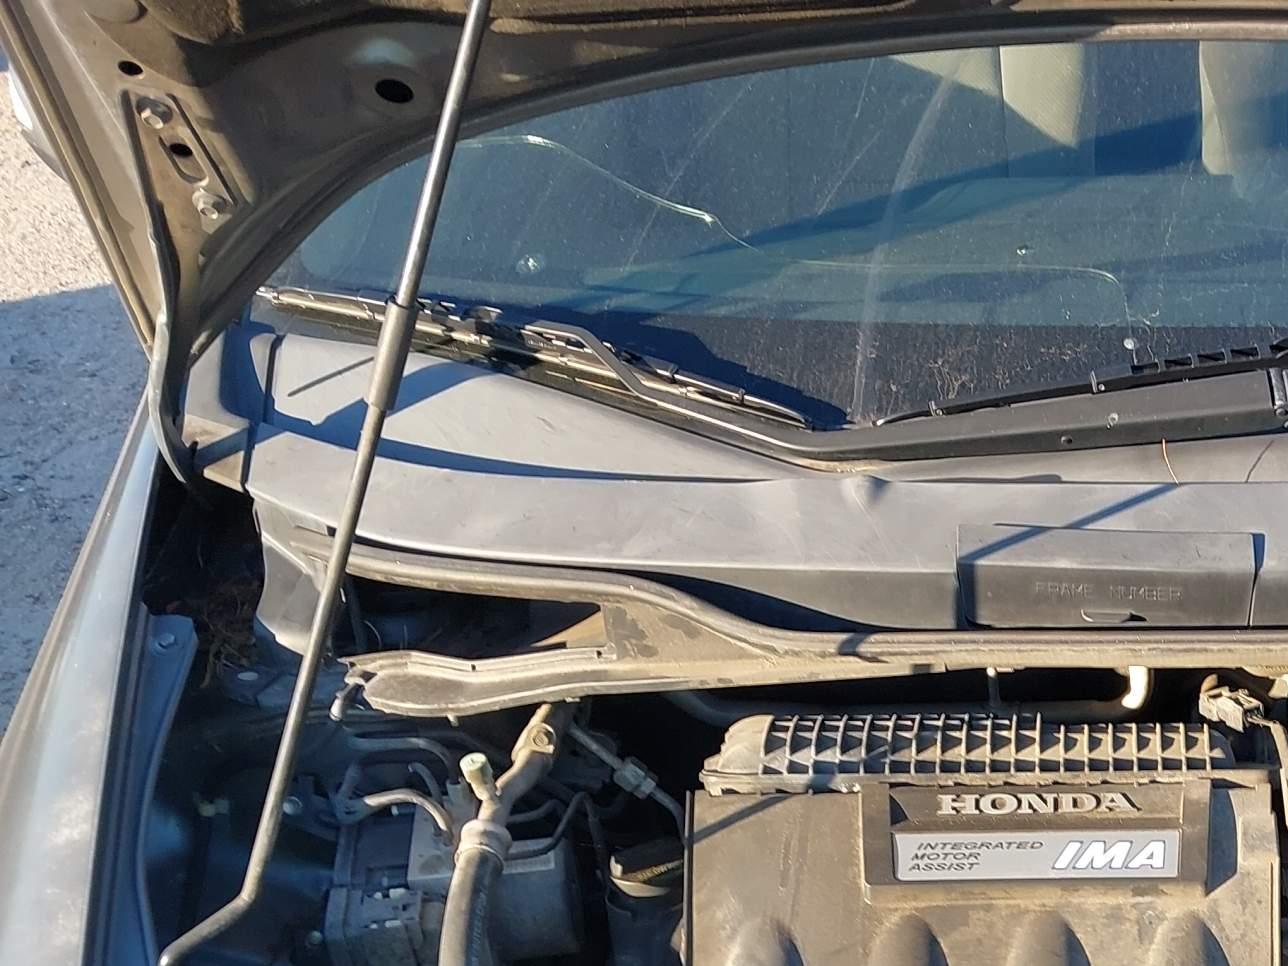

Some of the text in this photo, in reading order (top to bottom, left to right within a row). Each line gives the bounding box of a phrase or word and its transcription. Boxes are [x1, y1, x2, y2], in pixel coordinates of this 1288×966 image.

[1034, 582, 1183, 601] FRAME NUMBER
[936, 792, 1144, 815] HONDA
[917, 841, 1044, 851] INTEGRATED
[911, 852, 981, 861] MOTOR
[1052, 840, 1166, 870] IMA
[908, 862, 980, 872] ASSIST
